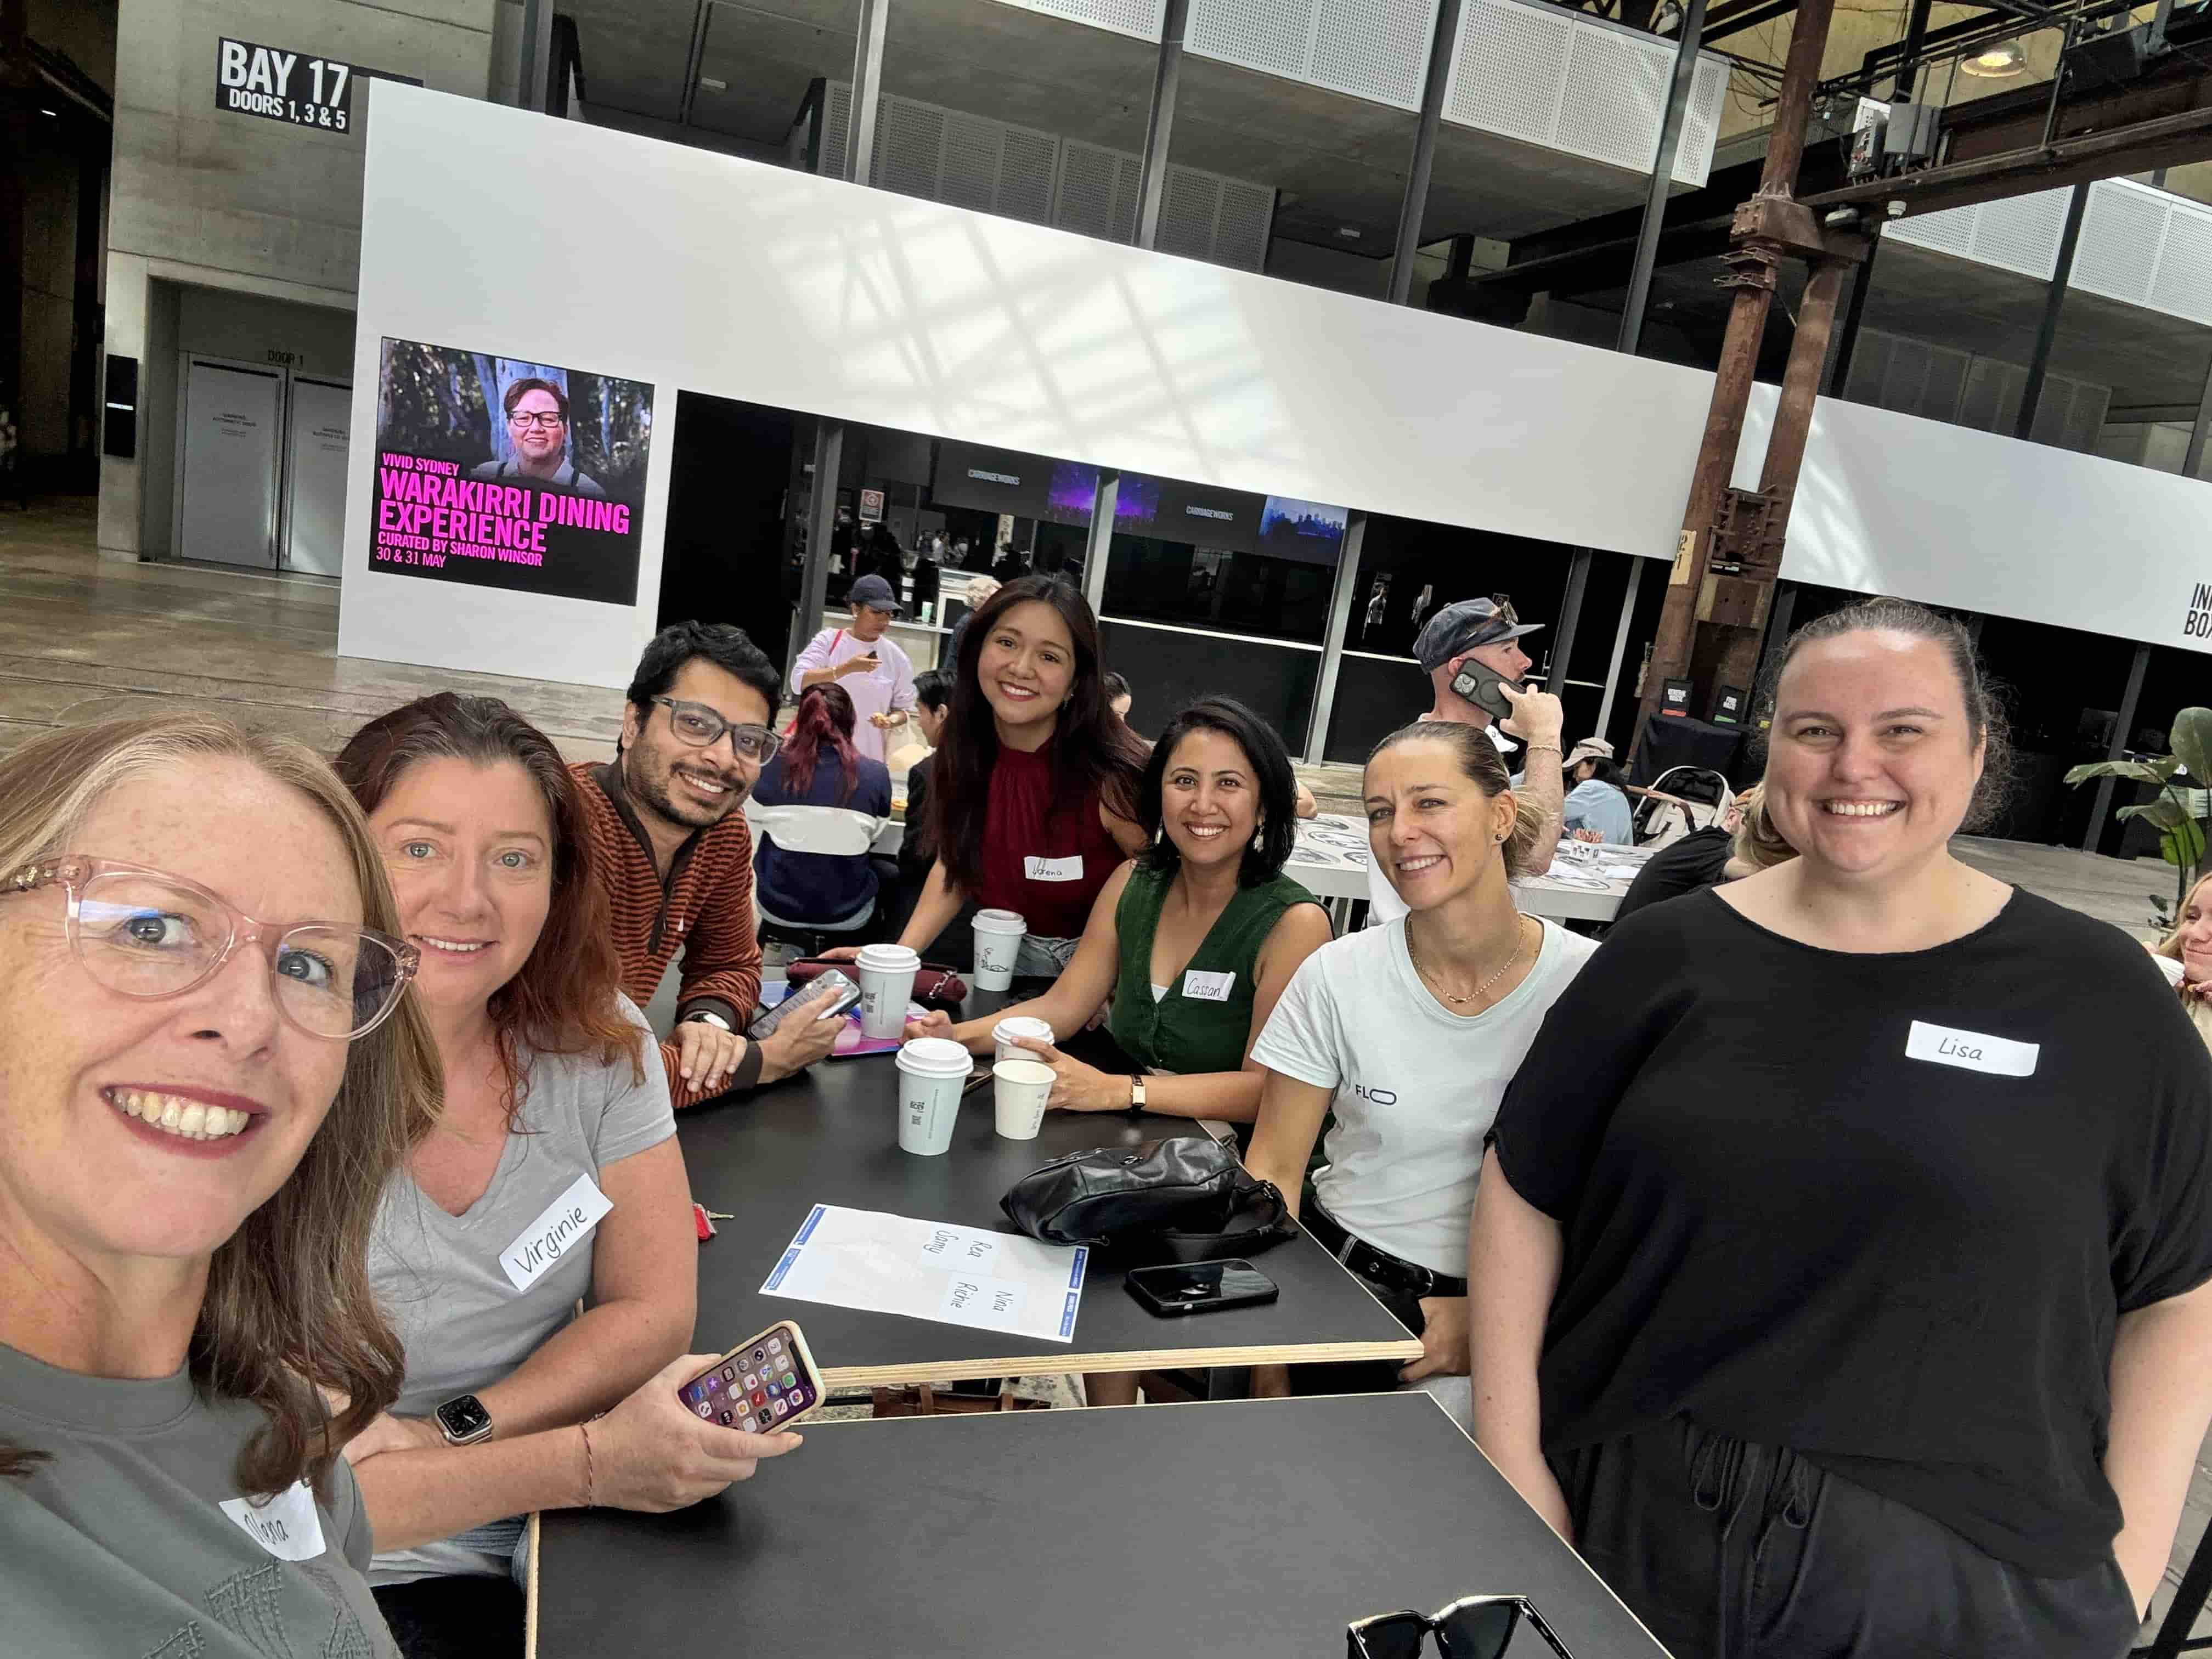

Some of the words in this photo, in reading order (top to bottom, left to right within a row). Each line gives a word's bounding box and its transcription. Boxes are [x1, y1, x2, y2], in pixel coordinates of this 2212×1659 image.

[221, 40, 297, 97] BAY
[309, 59, 349, 108] 17
[229, 88, 284, 116] DOORS
[289, 100, 300, 123] 1,
[304, 103, 314, 123] 3
[318, 106, 331, 127] &
[335, 110, 346, 130] 5
[382, 453, 414, 469] VIVID
[415, 458, 460, 476] SYDNEY
[380, 468, 531, 519] WARAKIRRI
[539, 492, 630, 534] DINING
[379, 500, 548, 552] EXPERIENCE
[375, 547, 391, 560] 30
[393, 551, 403, 563] &
[405, 552, 419, 566] 31
[422, 555, 446, 568] MAY
[378, 532, 429, 550] CURATED
[432, 538, 447, 553] BY
[450, 540, 495, 559] SHARON
[498, 548, 543, 566] WINSOR
[1938, 1037, 1983, 1060] Lisa
[1356, 1084, 1397, 1105] FLO
[514, 1207, 588, 1273] Virginie
[992, 1291, 1013, 1311] Nina
